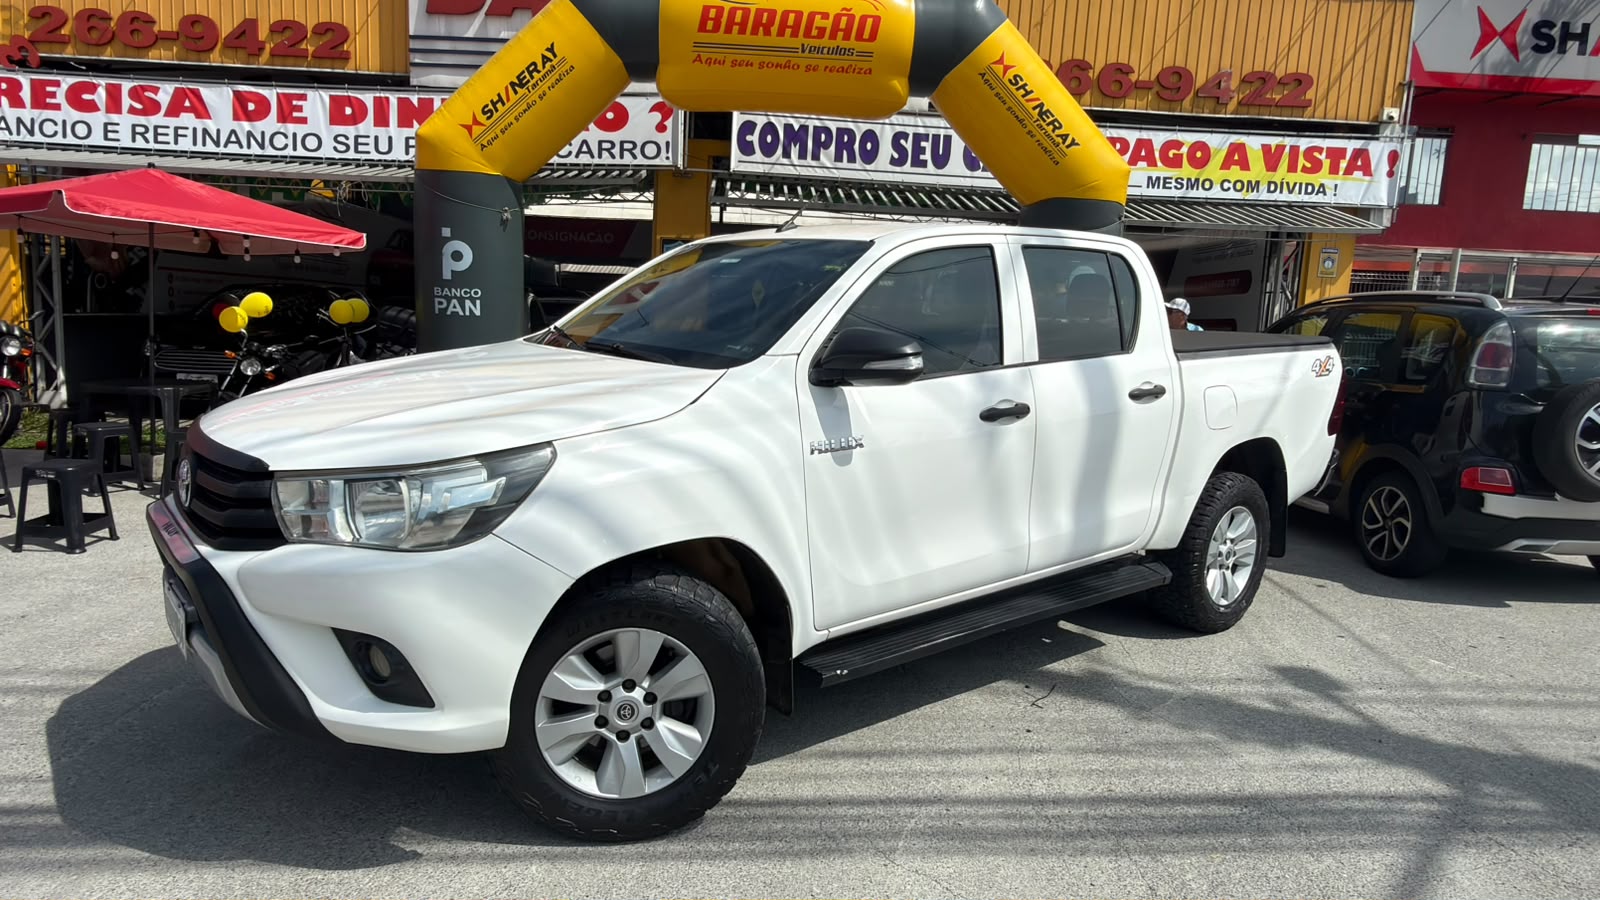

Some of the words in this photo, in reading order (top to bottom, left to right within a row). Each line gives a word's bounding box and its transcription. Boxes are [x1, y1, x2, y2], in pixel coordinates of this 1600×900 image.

[697, 5, 882, 43] BARAGÃO
[526, 64, 557, 95] Tarumã
[692, 54, 726, 68] Aqui
[730, 58, 754, 68] seu
[758, 60, 800, 71] sonho
[804, 64, 819, 73] se
[823, 64, 872, 75] realiza
[1042, 58, 1313, 108] 66-9422
[231, 90, 308, 125] DE
[480, 132, 499, 152] Aqui
[500, 122, 513, 136] seu
[514, 100, 537, 123] sonho
[538, 91, 547, 102] se
[547, 64, 575, 92] realiza
[978, 72, 997, 92] Aqui
[994, 92, 1007, 106] seu
[1006, 106, 1027, 130] sonho
[1026, 129, 1036, 139] se
[1035, 139, 1060, 166] realiza
[103, 122, 121, 142] E
[131, 123, 323, 153] REFINANCIO
[333, 134, 393, 155] SEU
[736, 119, 880, 165] COMPRO
[889, 130, 952, 170] SEU
[1105, 136, 1212, 170] PAGO
[1219, 142, 1252, 172] A
[1261, 143, 1374, 177] VISTA
[1146, 175, 1214, 192] MESMO
[1219, 178, 1260, 193] COM
[1266, 178, 1328, 197] DÍVIDA
[433, 286, 482, 298] BANCO
[434, 297, 481, 316] PAN
